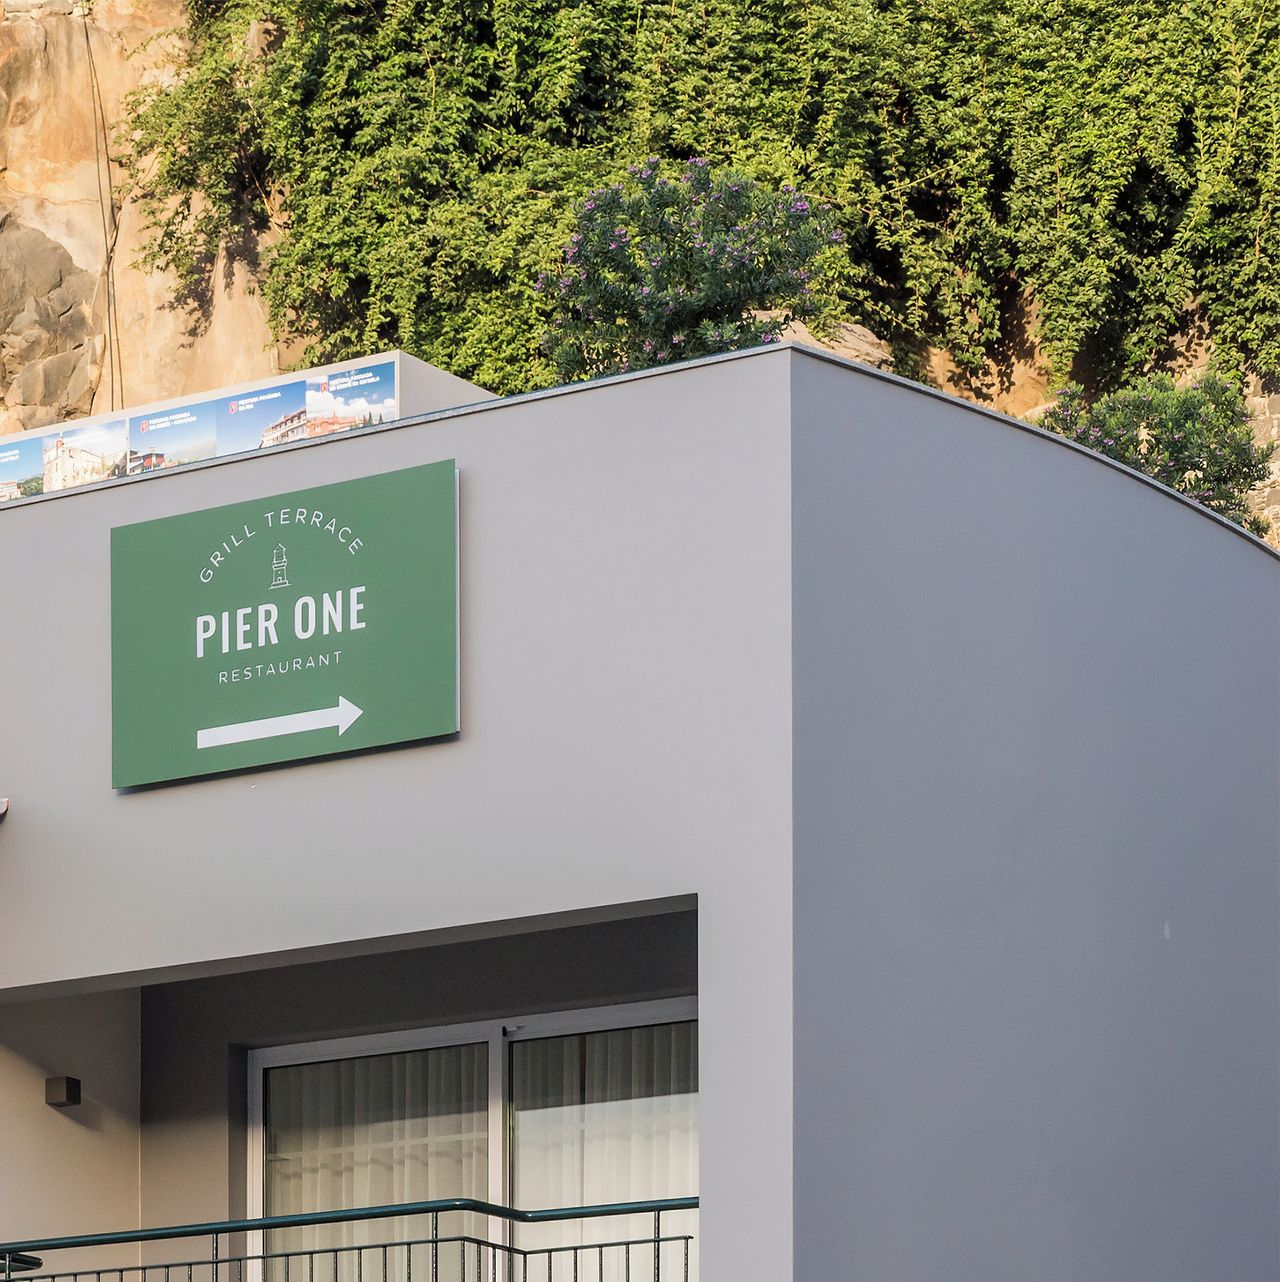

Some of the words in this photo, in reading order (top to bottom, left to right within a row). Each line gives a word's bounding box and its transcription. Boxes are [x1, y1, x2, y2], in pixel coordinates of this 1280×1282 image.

[199, 524, 256, 583] GRILL
[264, 508, 364, 555] TERRACE
[196, 603, 279, 658] PIER
[294, 585, 366, 640] ONE
[219, 650, 342, 684] RESTAURANT
